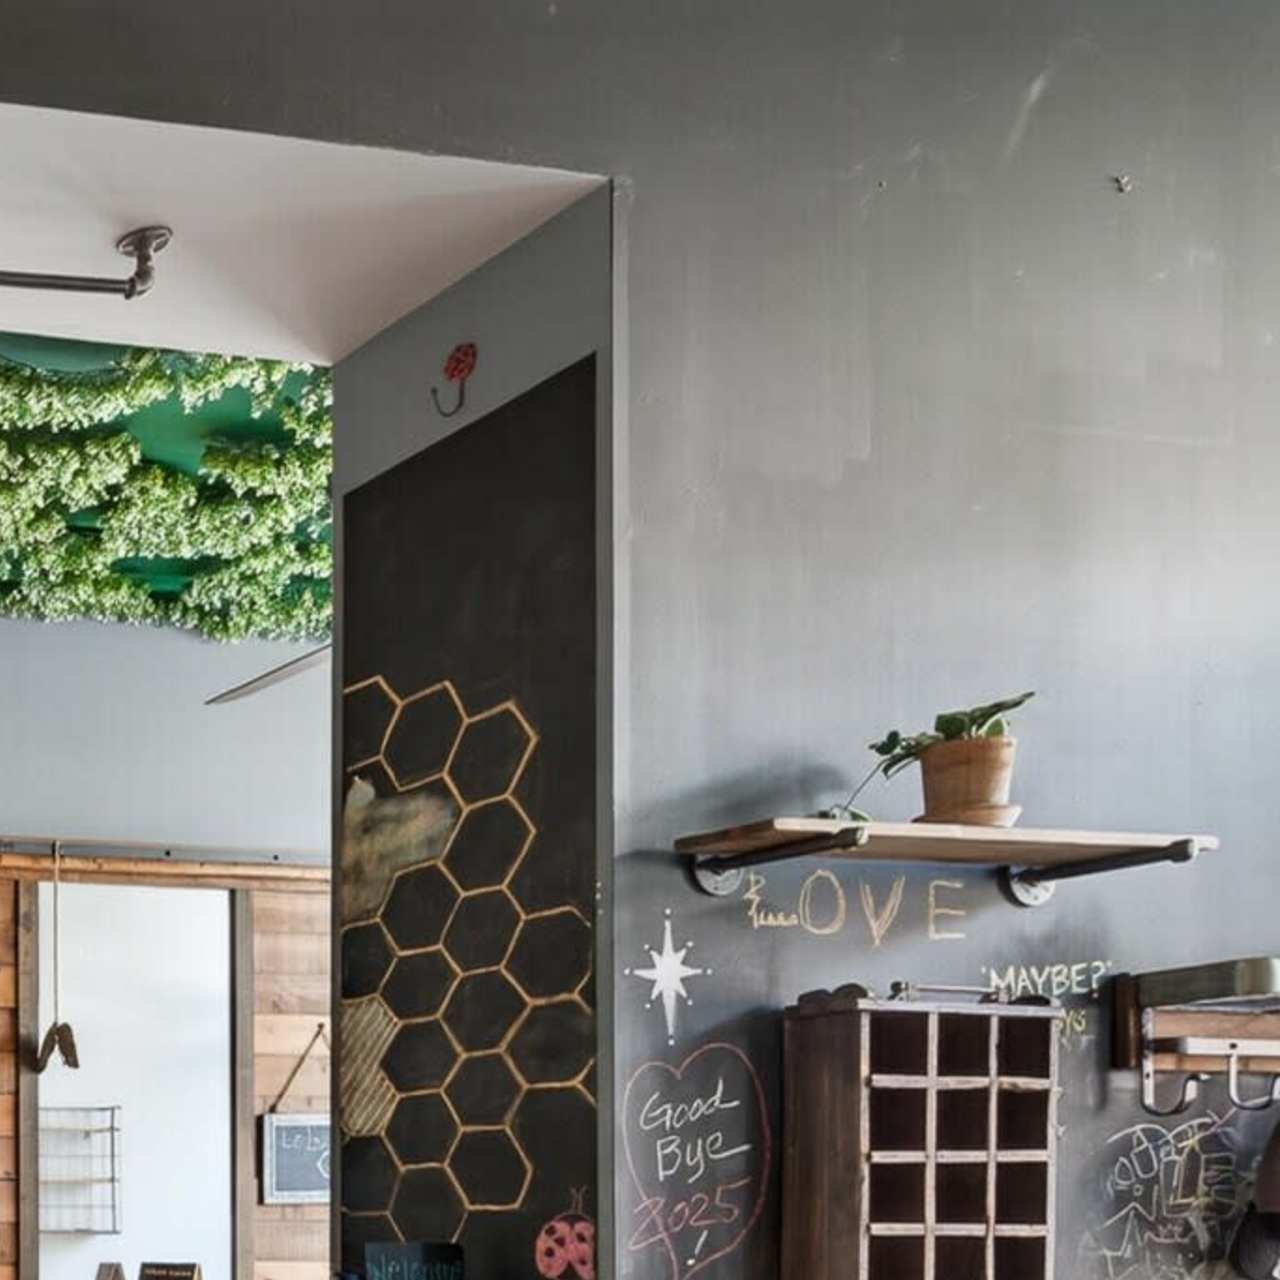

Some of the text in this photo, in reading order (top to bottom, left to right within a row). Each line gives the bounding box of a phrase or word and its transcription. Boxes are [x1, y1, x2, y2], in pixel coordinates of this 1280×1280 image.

[640, 1077, 740, 1131] Good
[656, 1131, 752, 1183] Bye
[629, 1177, 751, 1250] 2025
